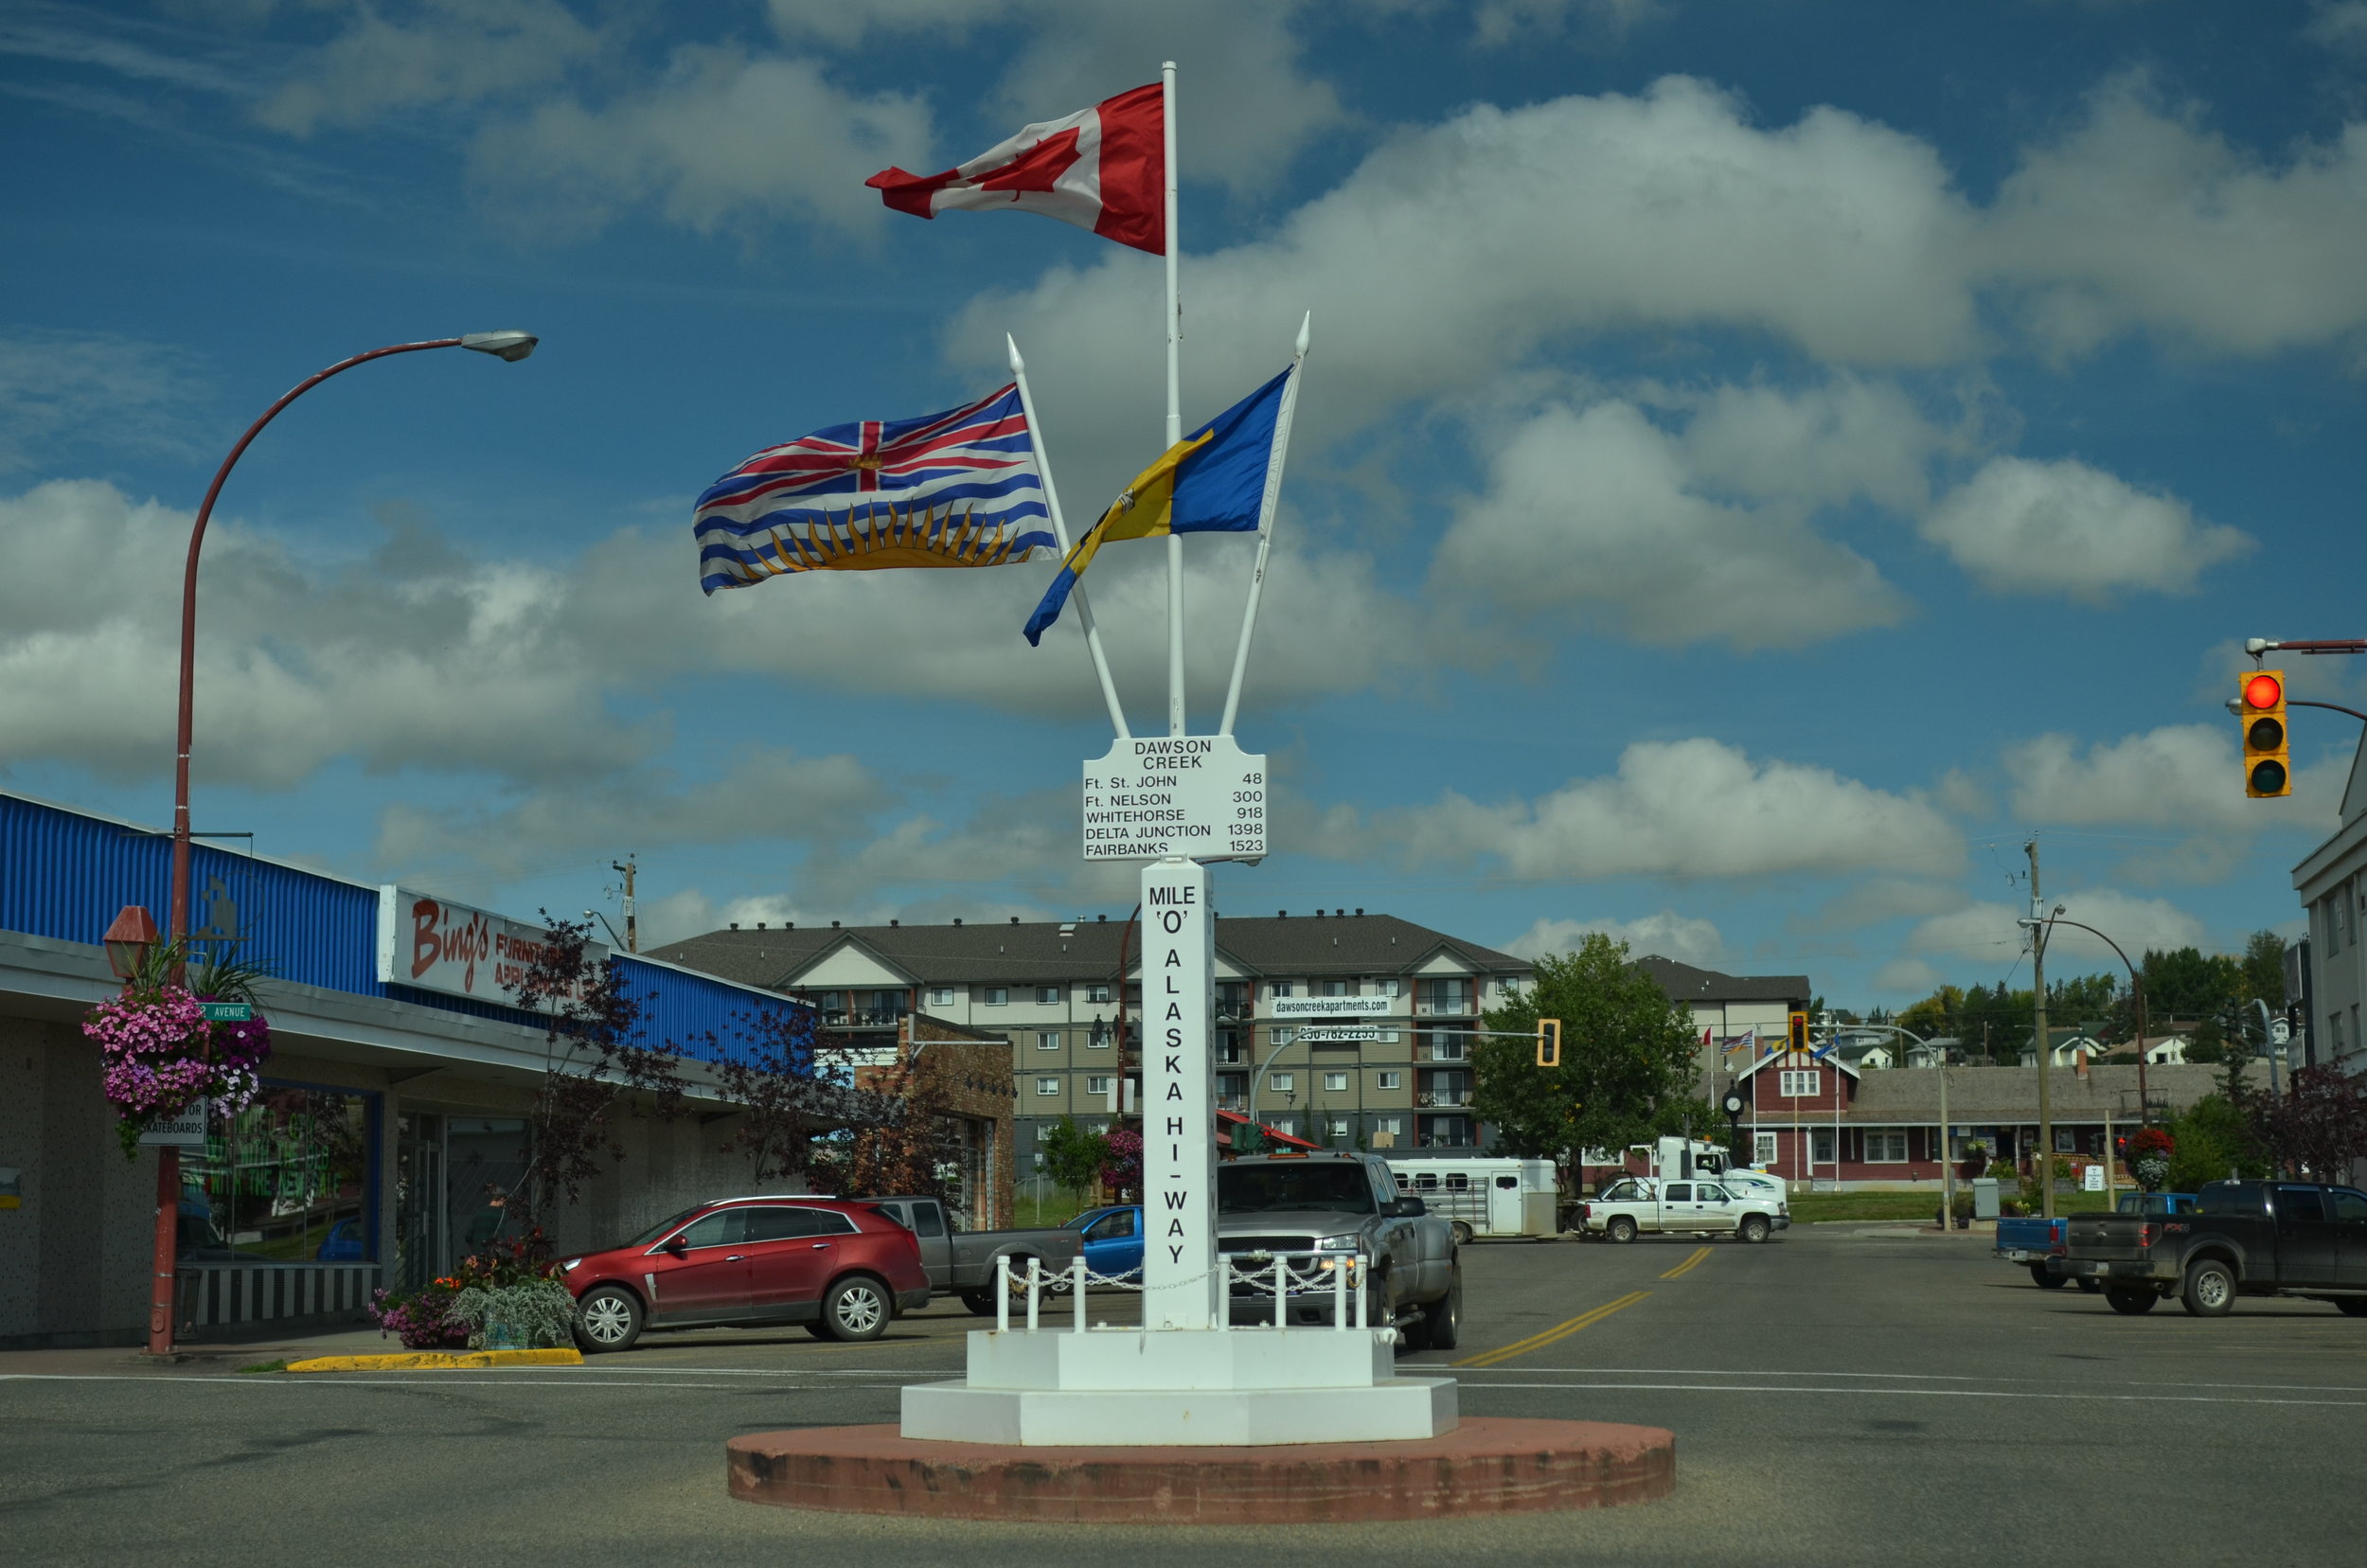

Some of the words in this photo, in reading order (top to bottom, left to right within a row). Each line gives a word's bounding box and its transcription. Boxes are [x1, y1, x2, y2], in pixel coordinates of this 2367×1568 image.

[1135, 740, 1211, 756] DAWSON
[1143, 756, 1202, 770] CREEK
[1085, 777, 1103, 790] Ft.
[1111, 776, 1130, 789] St.
[1136, 775, 1177, 788] JOHN
[1242, 773, 1262, 785] 48
[1085, 795, 1104, 808] Ft.
[1111, 793, 1171, 807] NELSON
[1233, 791, 1263, 803] 300
[1086, 809, 1185, 824] WHITEHORSE
[1237, 807, 1263, 819] 918
[1086, 827, 1130, 840] DELTA
[1135, 825, 1211, 839] JUNCTION
[1227, 823, 1263, 835] 1398
[1086, 842, 1168, 856] FAIRBANKS
[1229, 839, 1263, 851] 1523
[1149, 885, 1196, 905] MILE
[411, 899, 489, 993] Bing's
[214, 1007, 246, 1018] AVENUE
[1276, 1000, 1388, 1014] dawsoncreekapartments.com
[1165, 949, 1183, 1101] ALASKA
[188, 1104, 202, 1116] OR
